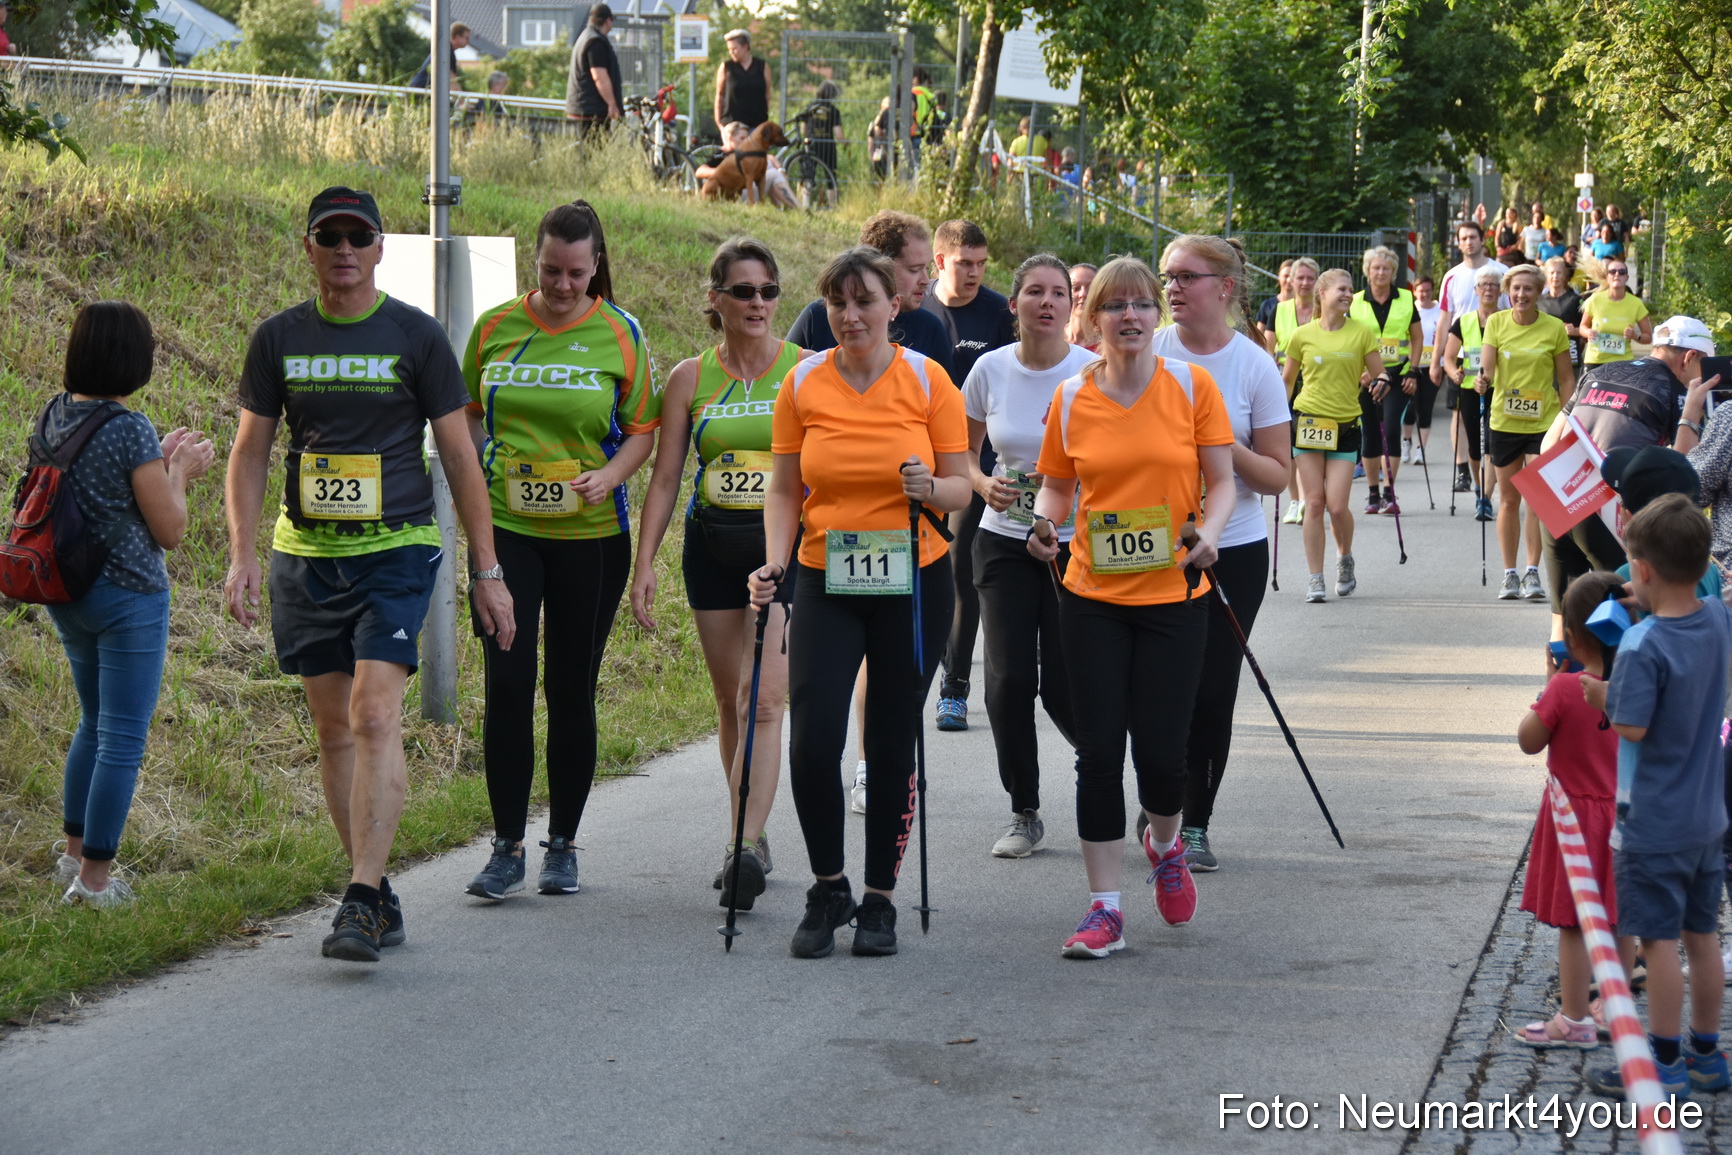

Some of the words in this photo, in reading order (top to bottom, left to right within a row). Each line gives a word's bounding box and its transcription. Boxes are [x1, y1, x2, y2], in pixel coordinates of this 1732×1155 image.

[1602, 340, 1622, 349] 1235
[285, 356, 398, 381] BOCK
[484, 362, 602, 390] BOCK
[315, 384, 326, 393] by
[355, 385, 394, 394] concepts
[1507, 398, 1538, 411] 1254
[1302, 428, 1332, 441] 1218
[315, 478, 361, 501] 323
[520, 482, 564, 502] 329
[720, 472, 764, 492] 322
[1567, 497, 1588, 514] DEHN
[1588, 483, 1609, 502] protec
[1106, 531, 1154, 556] 106
[844, 554, 888, 576] 111
